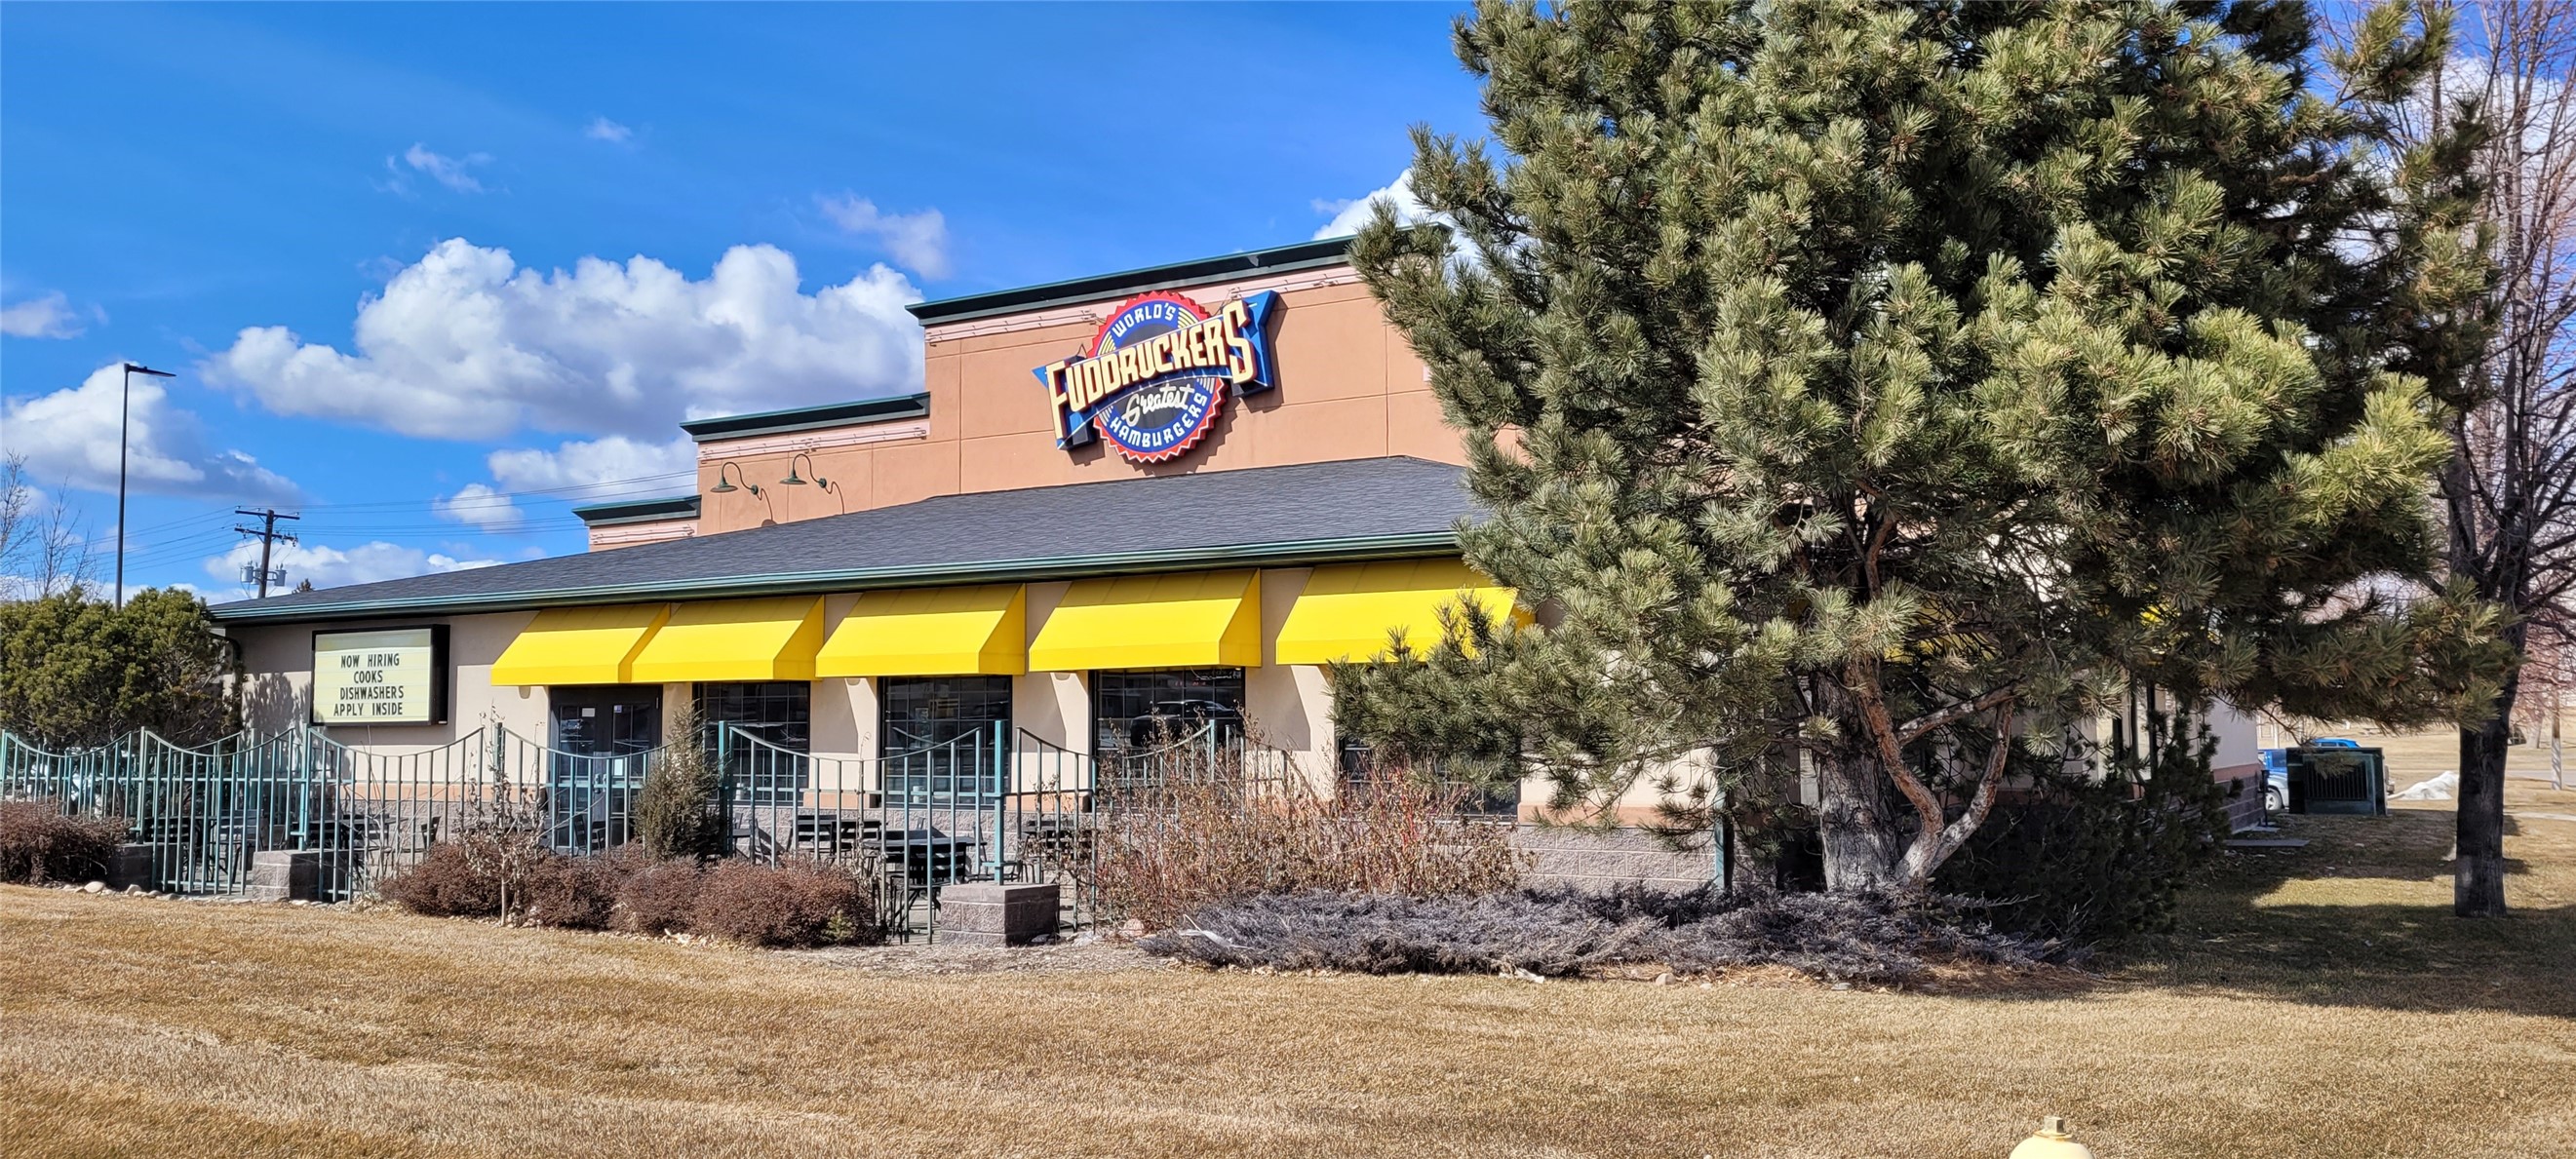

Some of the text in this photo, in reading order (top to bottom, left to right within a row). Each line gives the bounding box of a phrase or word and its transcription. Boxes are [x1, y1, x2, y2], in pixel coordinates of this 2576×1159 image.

[1112, 303, 1176, 337] WORLD'S
[1046, 299, 1256, 439] FUDDRUCKERS
[1122, 383, 1195, 427] Greatest
[1111, 392, 1208, 448] HAMBURGERS
[340, 653, 400, 669] NOW HIRING
[353, 670, 383, 684] COOKS
[339, 685, 405, 700] DISHWASHERS
[333, 702, 403, 716] APPLY INSIDE
